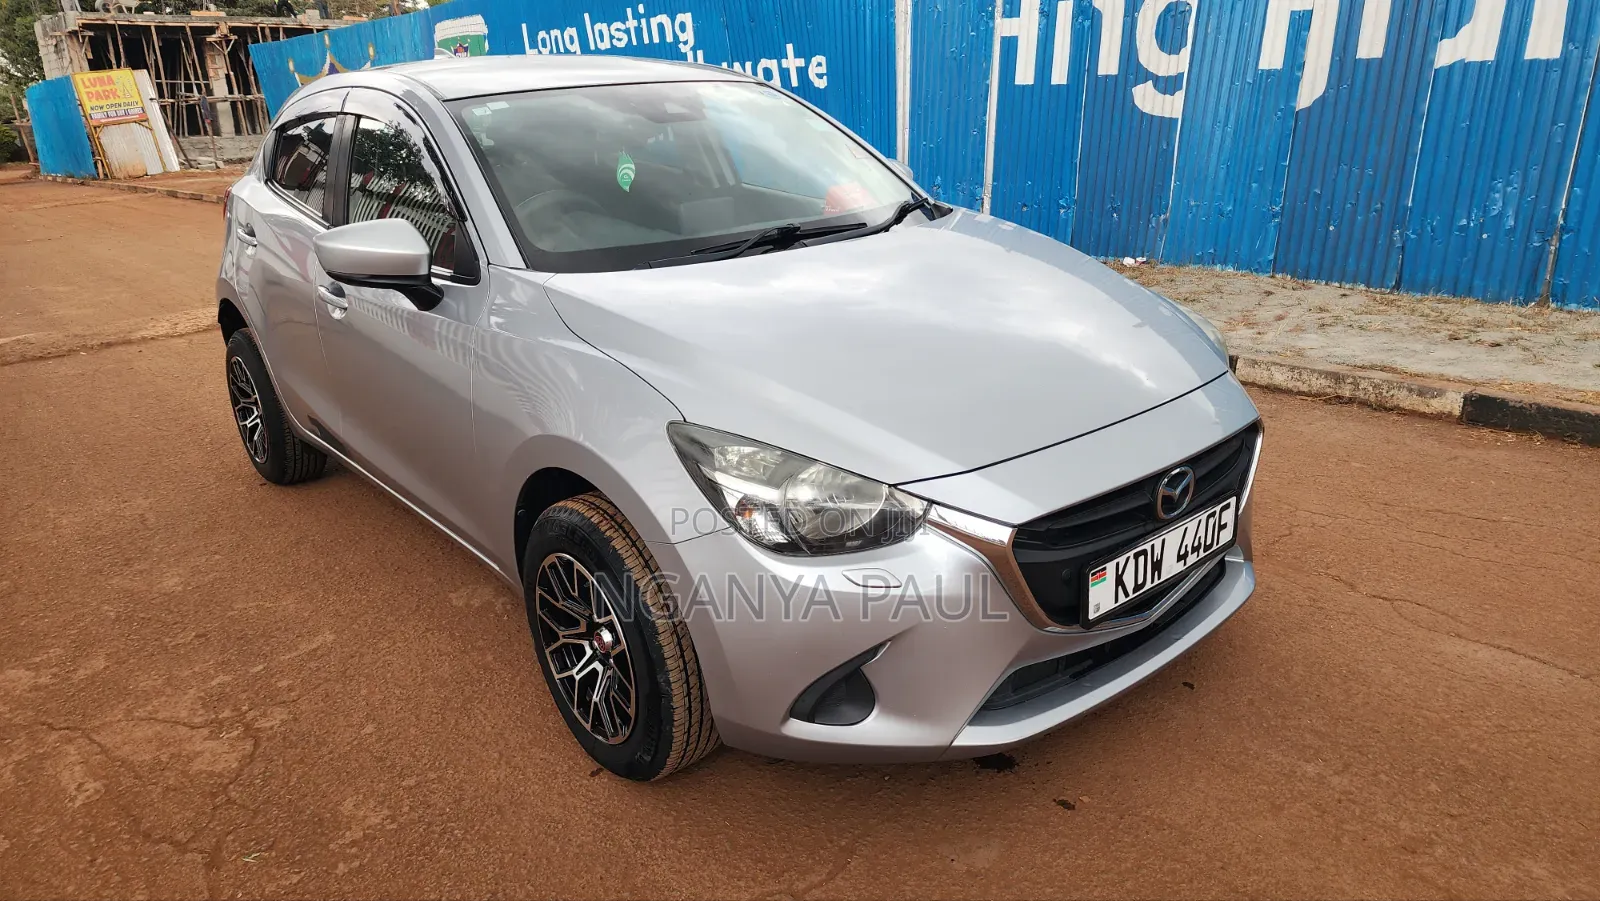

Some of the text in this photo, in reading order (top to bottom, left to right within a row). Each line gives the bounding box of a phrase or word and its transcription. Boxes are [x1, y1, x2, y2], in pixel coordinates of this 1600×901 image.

[521, 4, 695, 55] Long lasting
[81, 75, 115, 89] LUNA
[85, 88, 120, 102] PARK
[106, 102, 122, 110] OPEN
[123, 100, 139, 108] DAILY
[1114, 503, 1231, 604] KDW 440F
